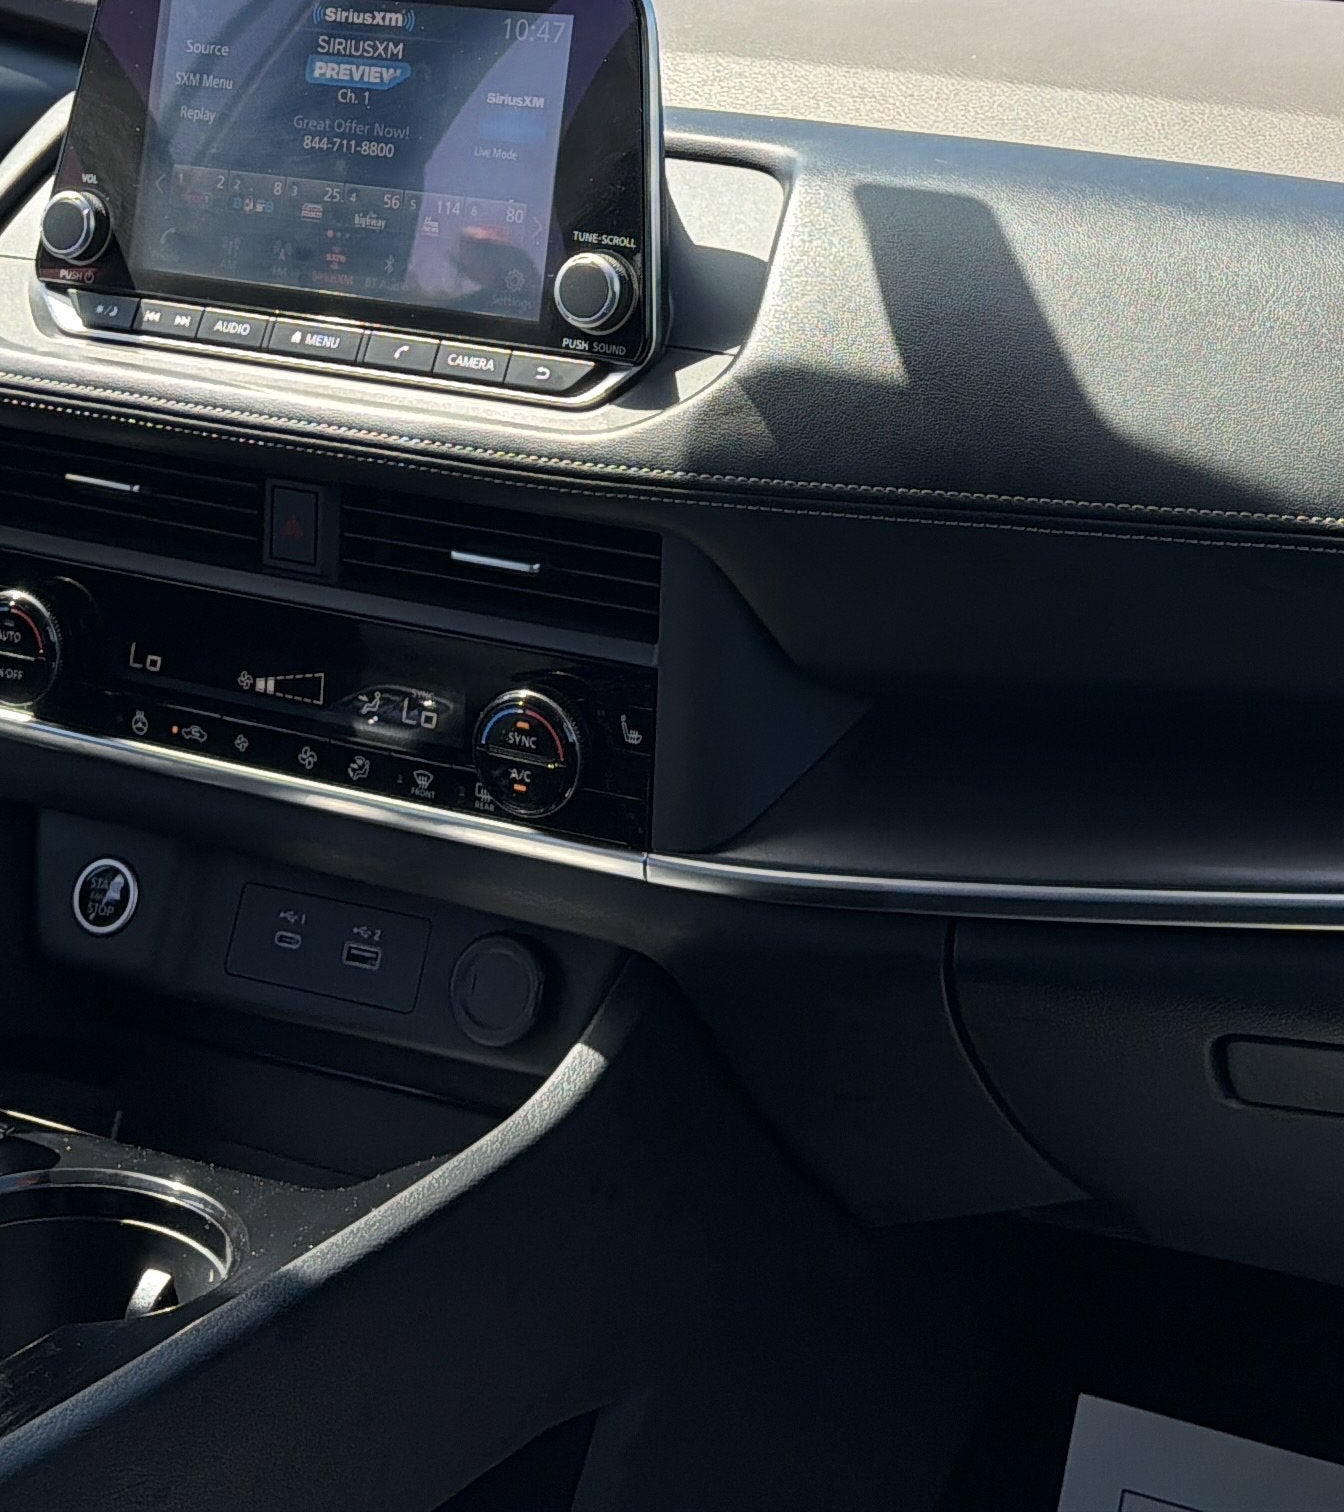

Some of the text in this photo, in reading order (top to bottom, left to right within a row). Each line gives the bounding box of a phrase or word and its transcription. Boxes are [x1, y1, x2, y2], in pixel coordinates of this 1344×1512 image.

[504, 17, 567, 43] 10:47
[186, 39, 230, 56] Source
[317, 35, 404, 59] SIRIUSXM
[175, 71, 233, 89] SXM Menu
[313, 61, 402, 84] PREVIEW
[337, 89, 370, 105] Ch. 1
[486, 92, 545, 108] SiriusXM
[180, 105, 217, 125] Replay
[293, 115, 411, 139] Great Offer Now!
[303, 135, 395, 158] 844-711-8800
[474, 146, 519, 161] Live Mode
[81, 173, 98, 184] VOL
[216, 175, 226, 189] 2
[273, 181, 283, 196] 8
[290, 185, 298, 196] 3
[323, 188, 340, 202] 25
[383, 194, 400, 210] 56
[437, 200, 461, 216] 114
[506, 208, 524, 223] 80
[59, 269, 83, 280] PUSH
[213, 319, 250, 336] AUDIO
[304, 332, 341, 349] MENU
[562, 337, 627, 356] PUSH SOUND
[447, 353, 495, 371] CAMERA
[129, 641, 161, 672] Lo
[402, 696, 437, 729] Lo
[507, 731, 538, 749] SYNC
[509, 767, 532, 783] A/C
[410, 787, 436, 800] FRONT
[474, 800, 495, 813] REAR
[87, 901, 115, 917] STOP
